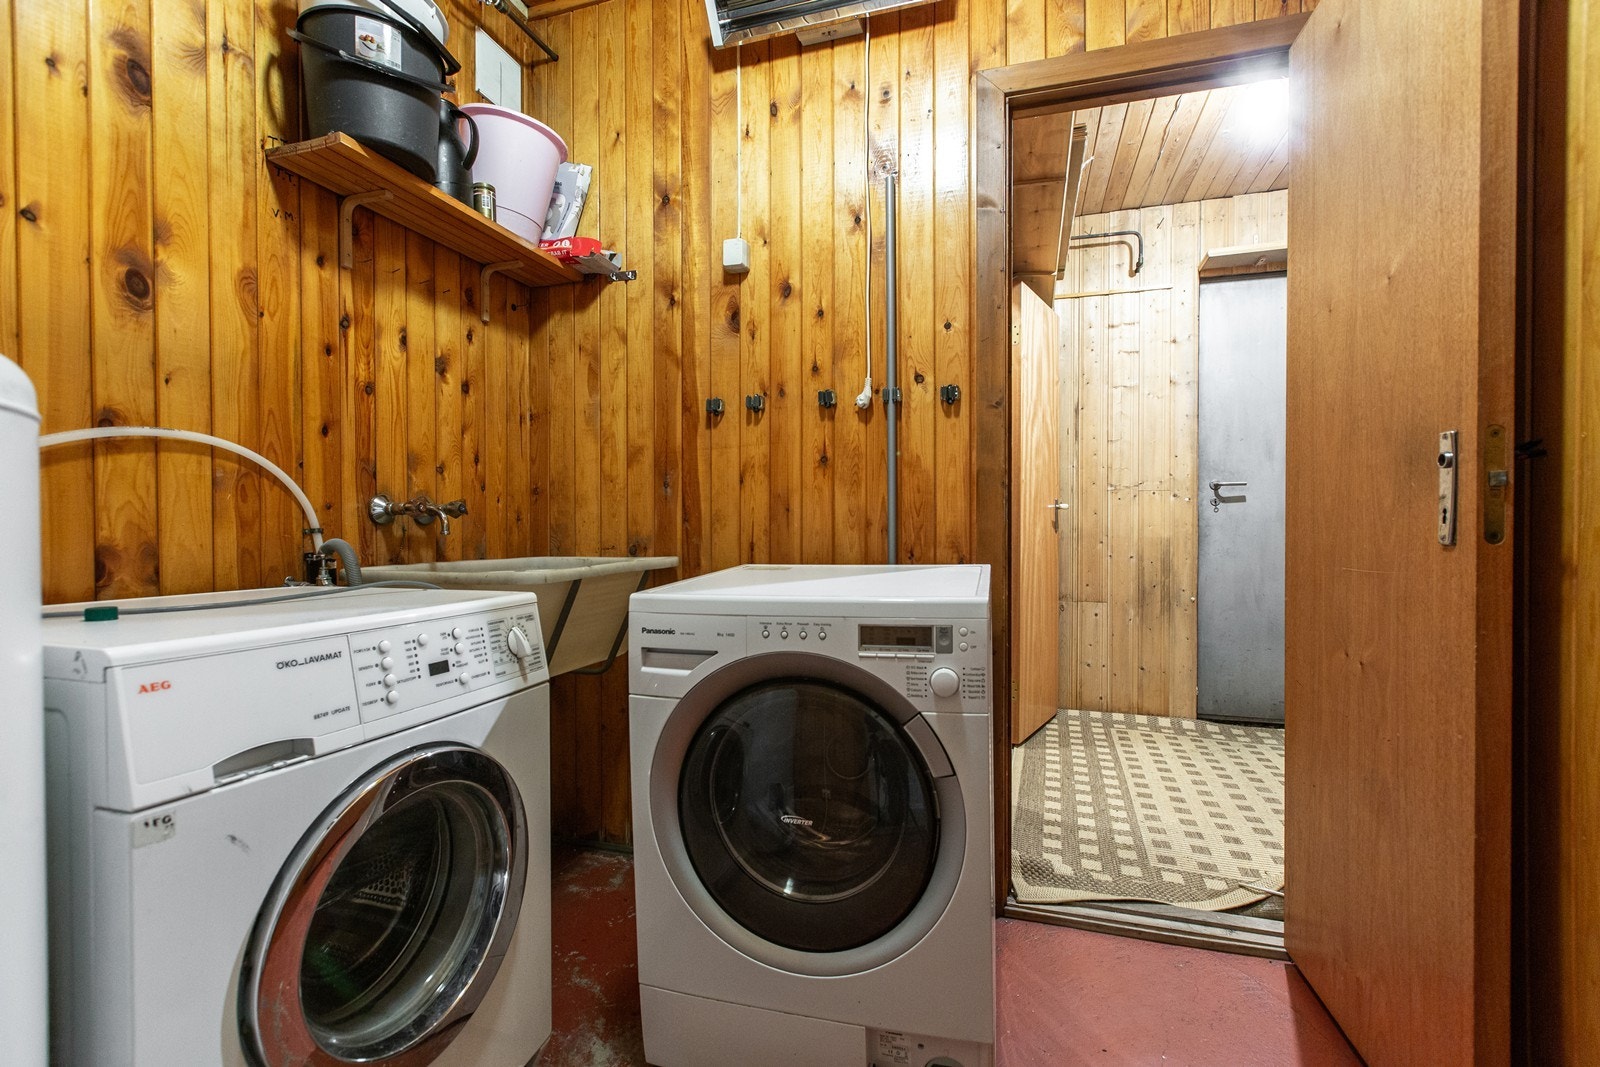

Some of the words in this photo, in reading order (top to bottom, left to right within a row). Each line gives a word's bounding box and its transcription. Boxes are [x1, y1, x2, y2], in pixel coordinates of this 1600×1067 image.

[641, 627, 676, 635] Panasonic
[137, 680, 172, 694] AEG
[783, 818, 813, 826] INVERTER
